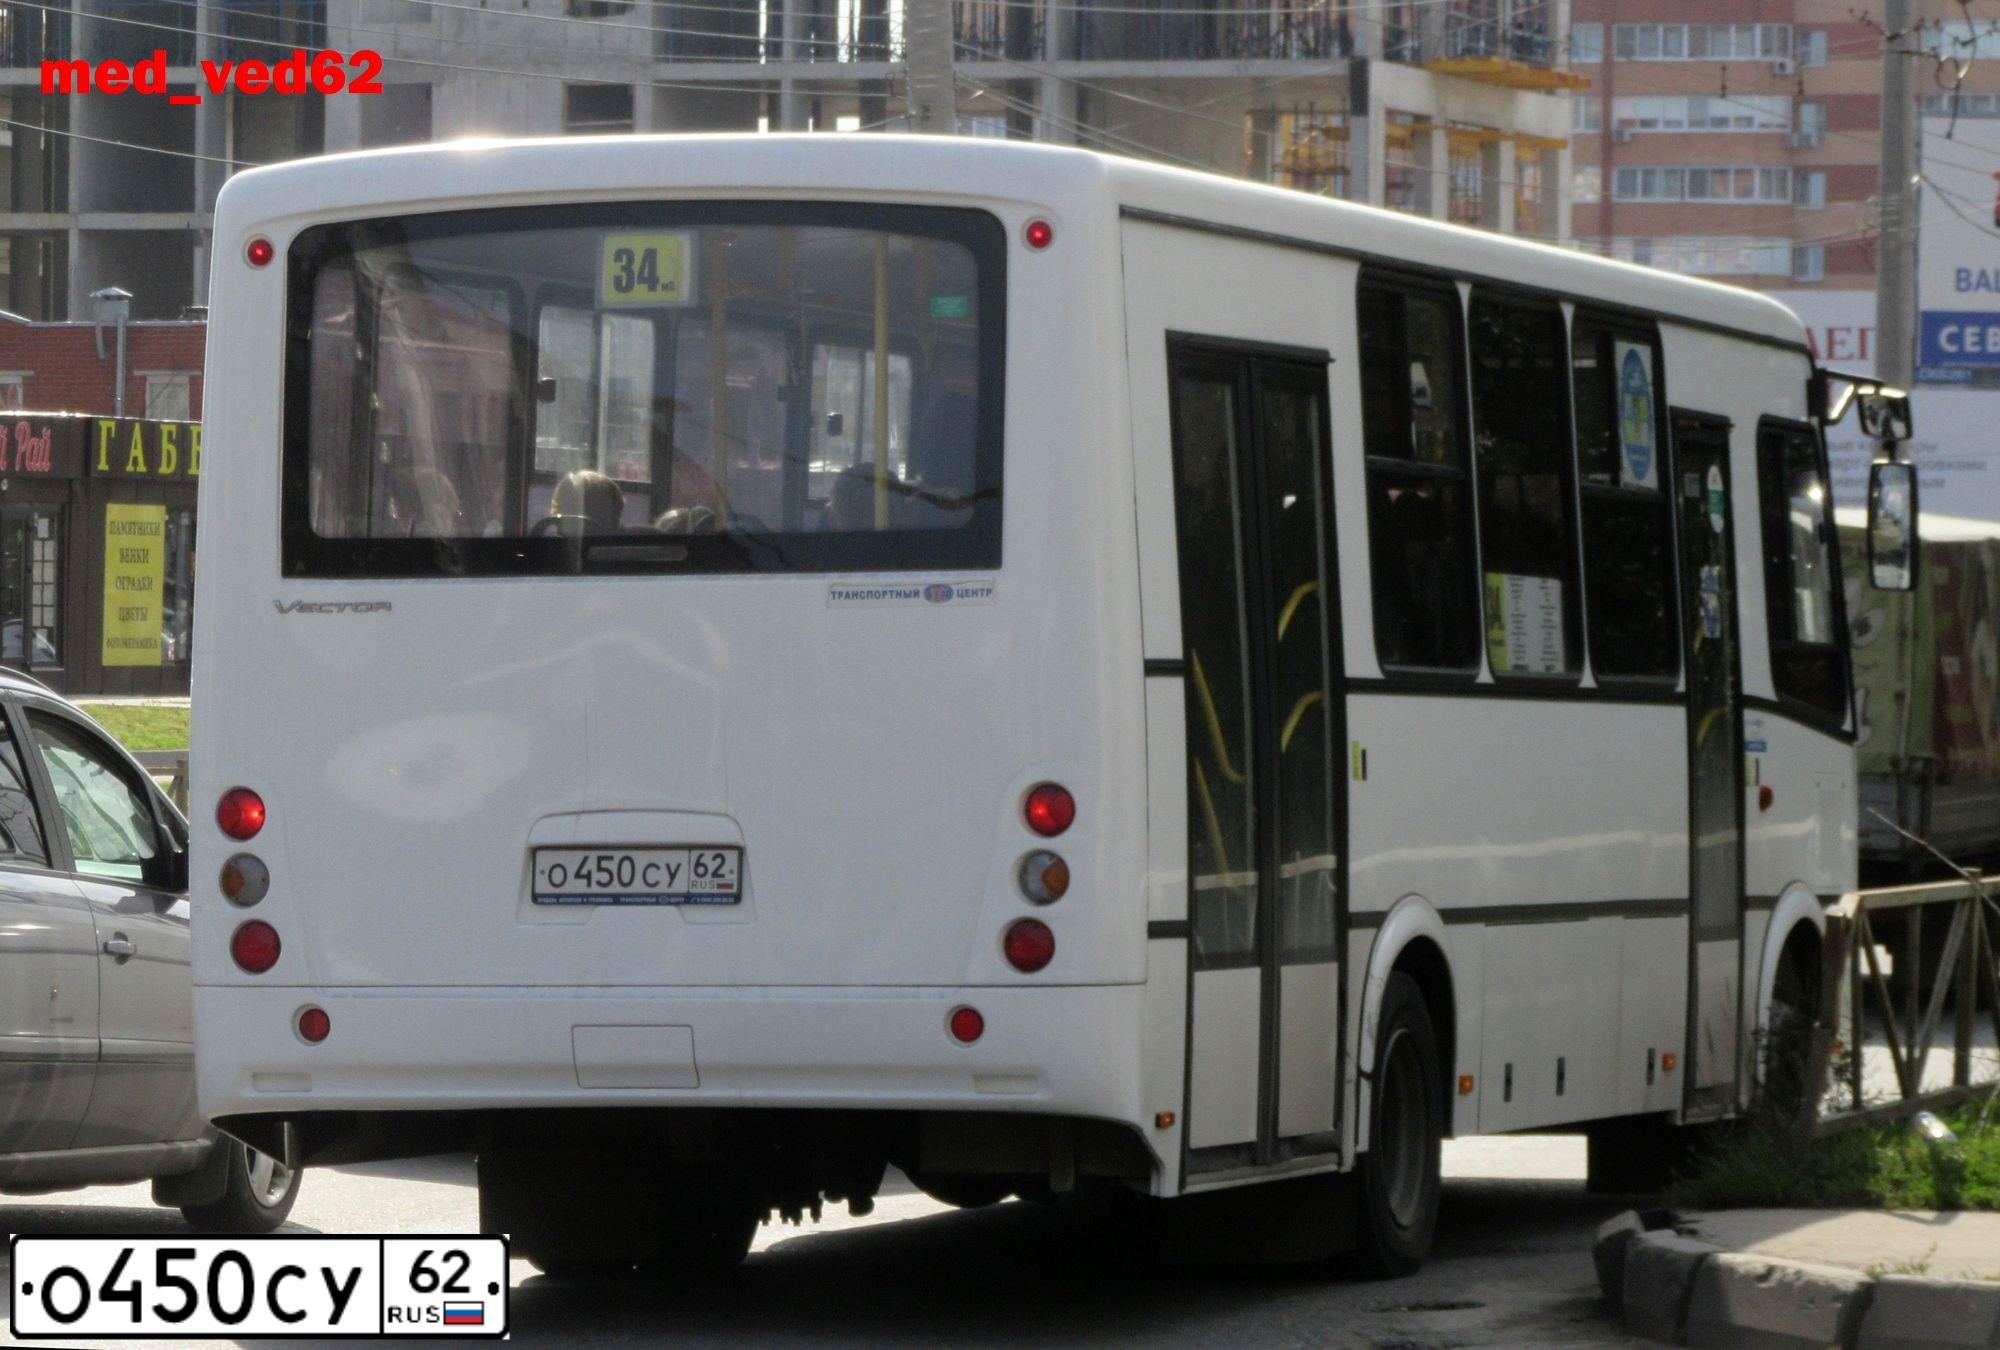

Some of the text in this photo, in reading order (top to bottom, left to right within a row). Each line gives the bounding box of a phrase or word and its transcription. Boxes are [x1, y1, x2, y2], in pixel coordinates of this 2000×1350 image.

[613, 248, 659, 293] 34
[831, 589, 920, 600] ТРАНСПОРТНЫЙ
[957, 588, 992, 598] ЦЕНТР
[693, 853, 726, 878] 62
[691, 880, 715, 890] RUS
